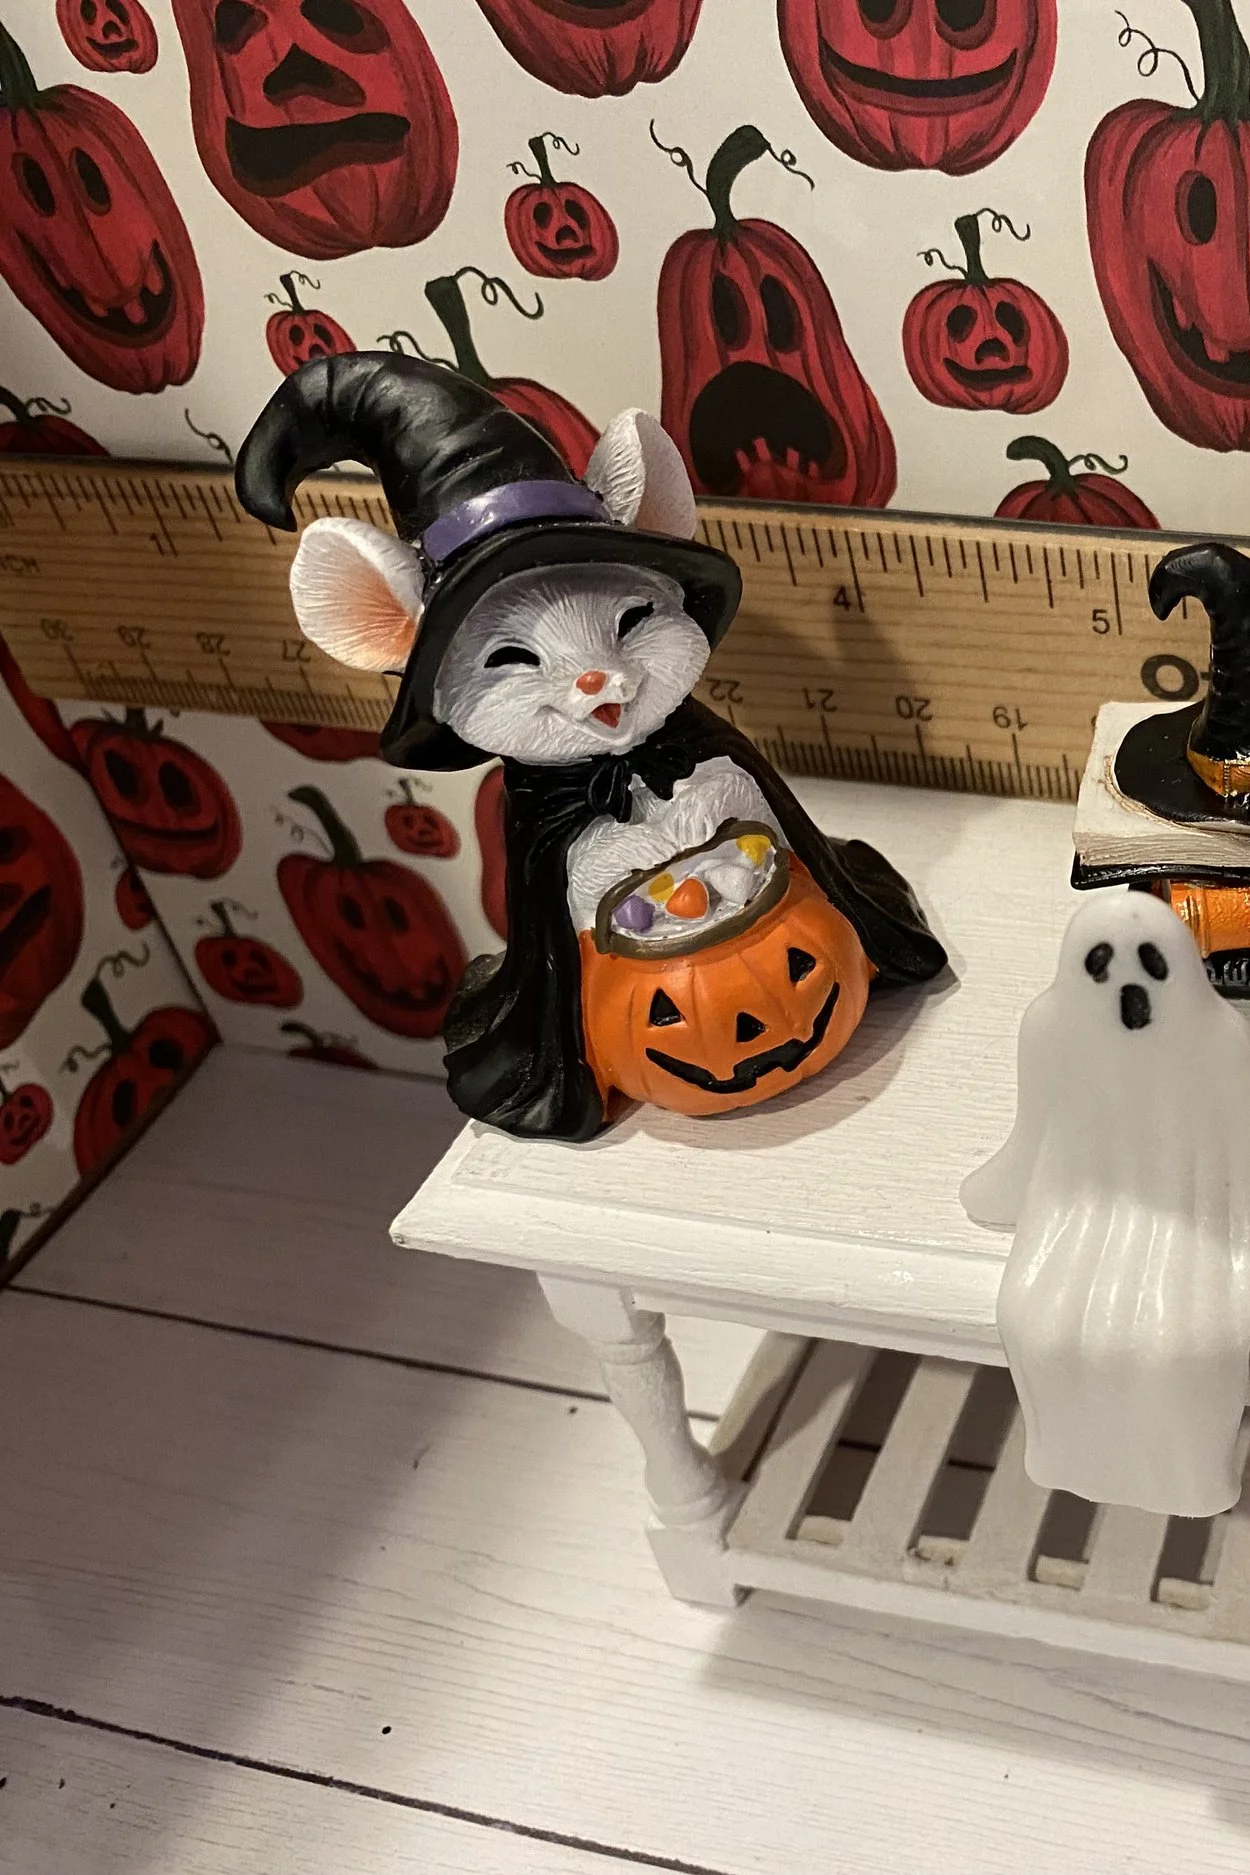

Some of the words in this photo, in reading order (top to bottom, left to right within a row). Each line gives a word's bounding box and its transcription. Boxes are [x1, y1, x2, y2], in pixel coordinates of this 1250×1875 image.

[832, 585, 852, 611] 4
[1091, 609, 1111, 635] 5
[704, 676, 743, 703] 22
[802, 687, 838, 712] 21
[895, 695, 933, 722] 20
[992, 705, 1028, 732] 19
